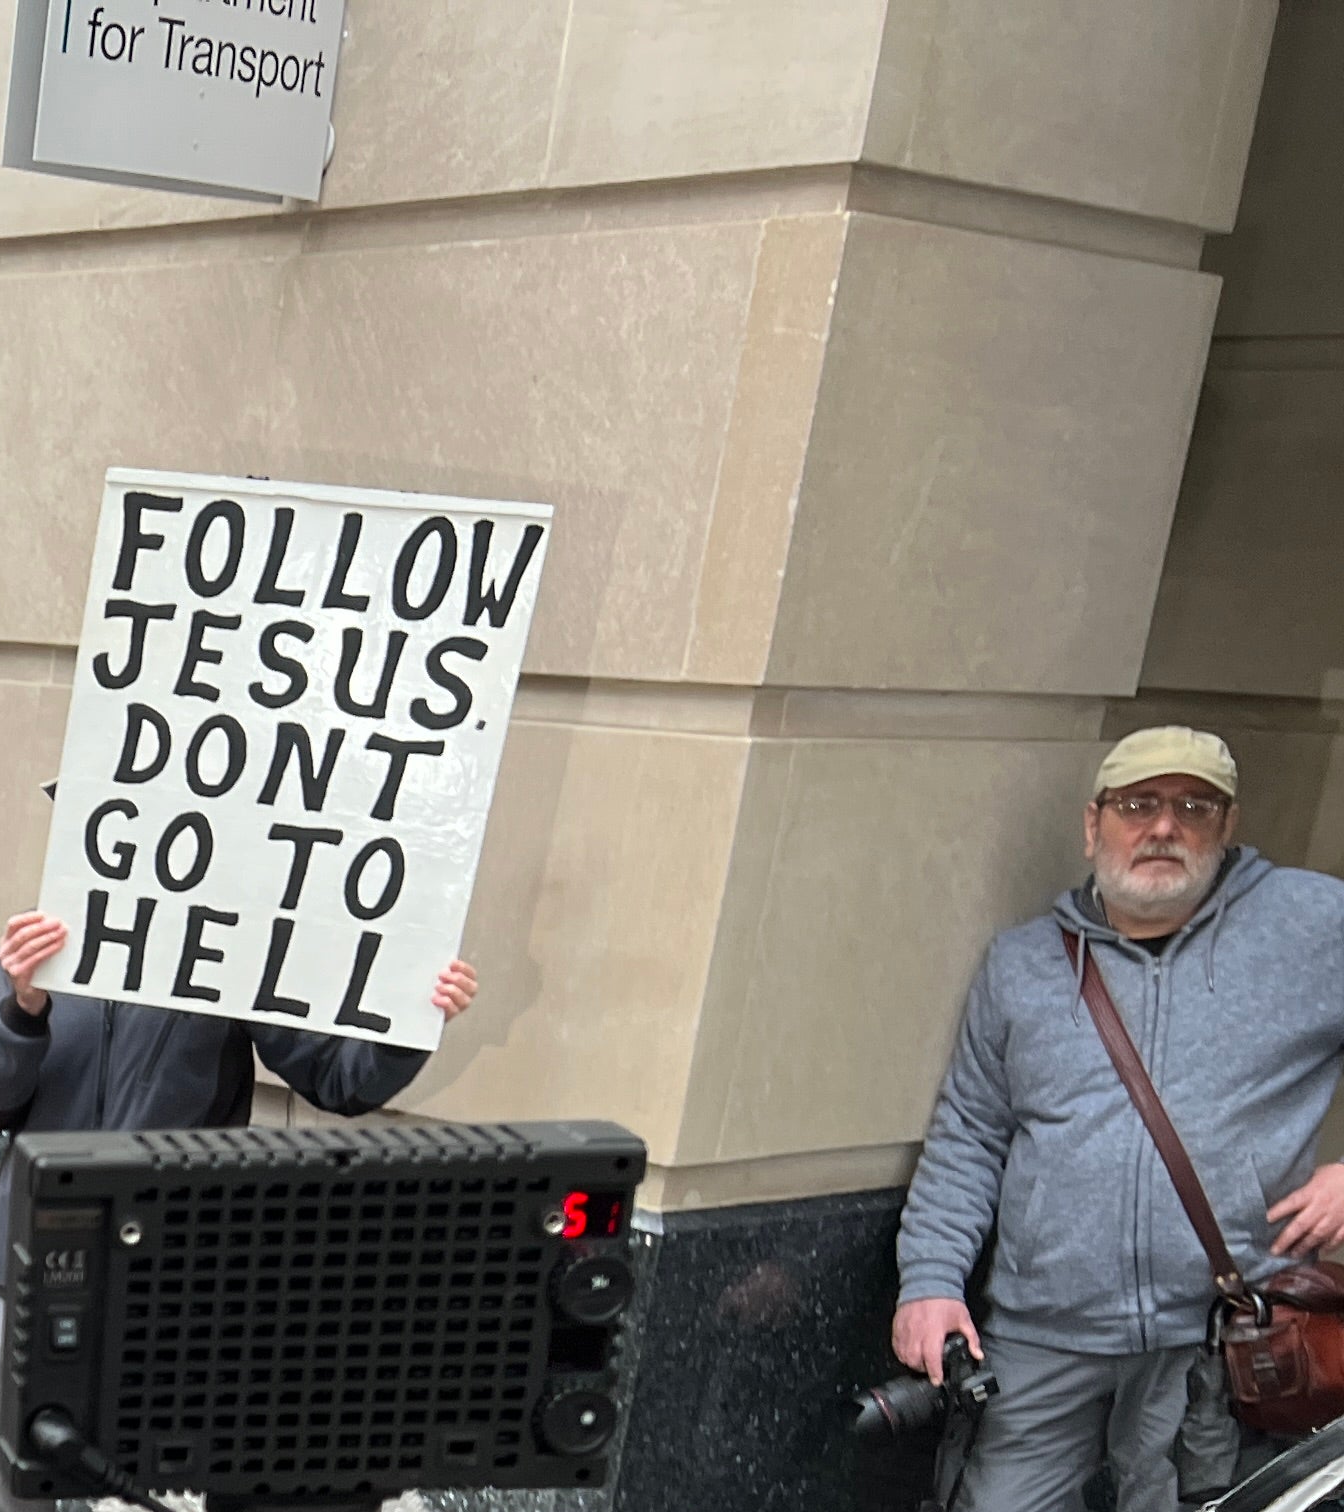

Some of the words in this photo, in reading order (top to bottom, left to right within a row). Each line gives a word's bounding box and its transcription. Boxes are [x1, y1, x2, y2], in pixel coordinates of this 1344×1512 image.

[88, 7, 145, 63] for
[158, 16, 325, 98] Transport
[112, 491, 544, 628] FOLLOW
[113, 703, 444, 821] DONT
[84, 799, 213, 892] GO
[268, 823, 405, 920] TO
[72, 890, 391, 1033] HELL
